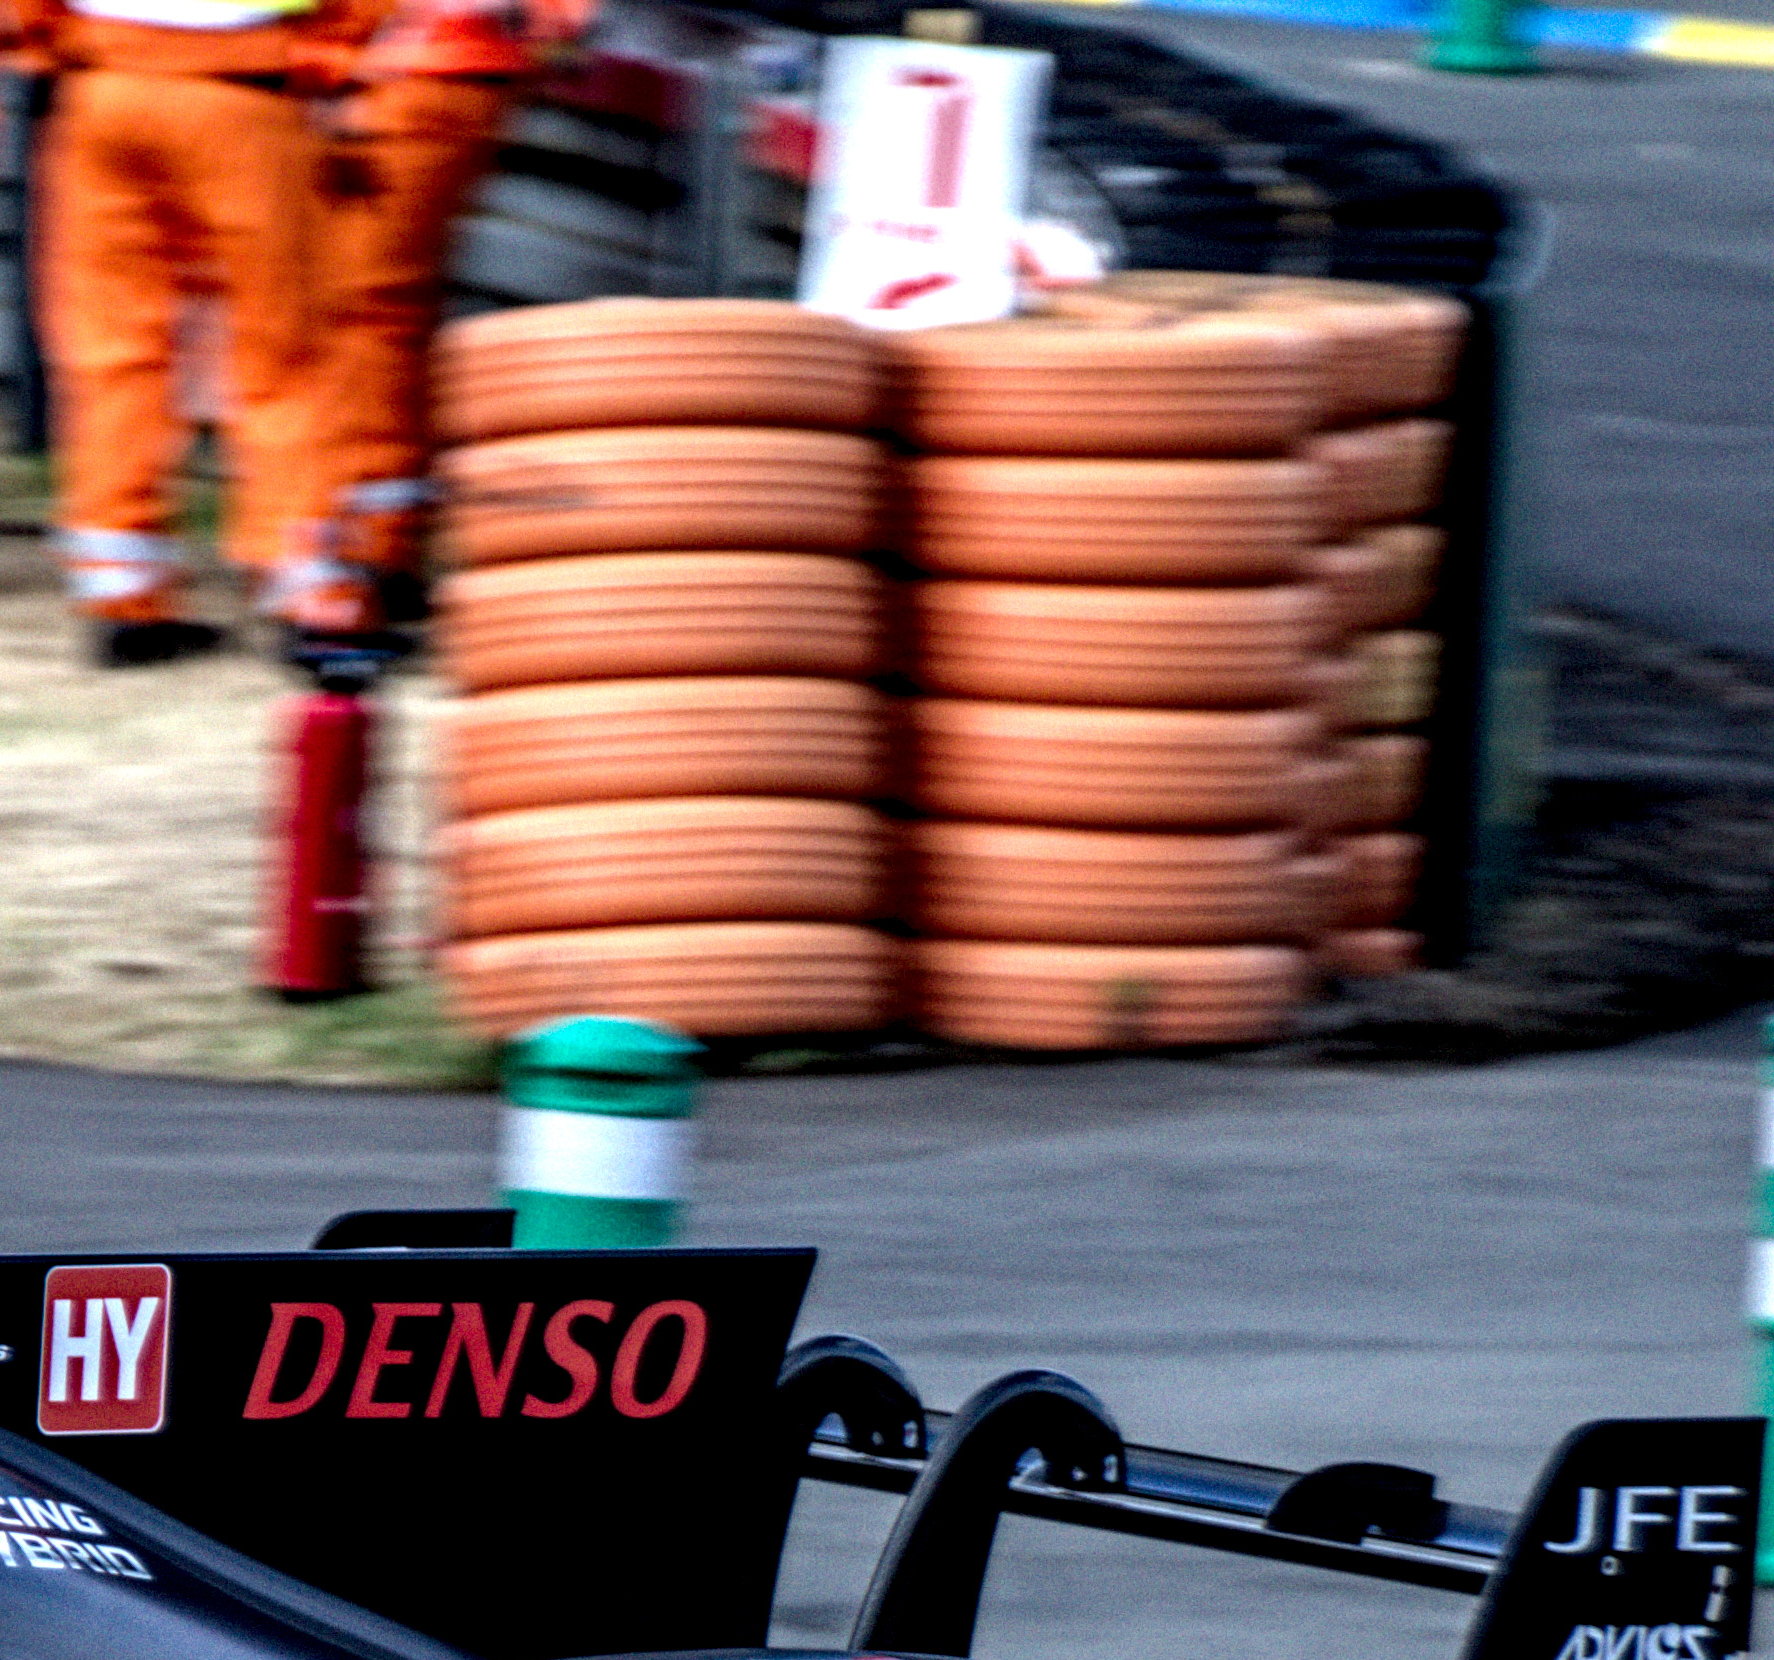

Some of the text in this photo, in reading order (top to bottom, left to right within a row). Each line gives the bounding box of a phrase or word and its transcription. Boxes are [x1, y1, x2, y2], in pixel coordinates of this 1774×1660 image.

[49, 1297, 158, 1403] HY
[243, 1299, 708, 1420] DENSO
[1544, 1486, 1744, 1552] JFE
